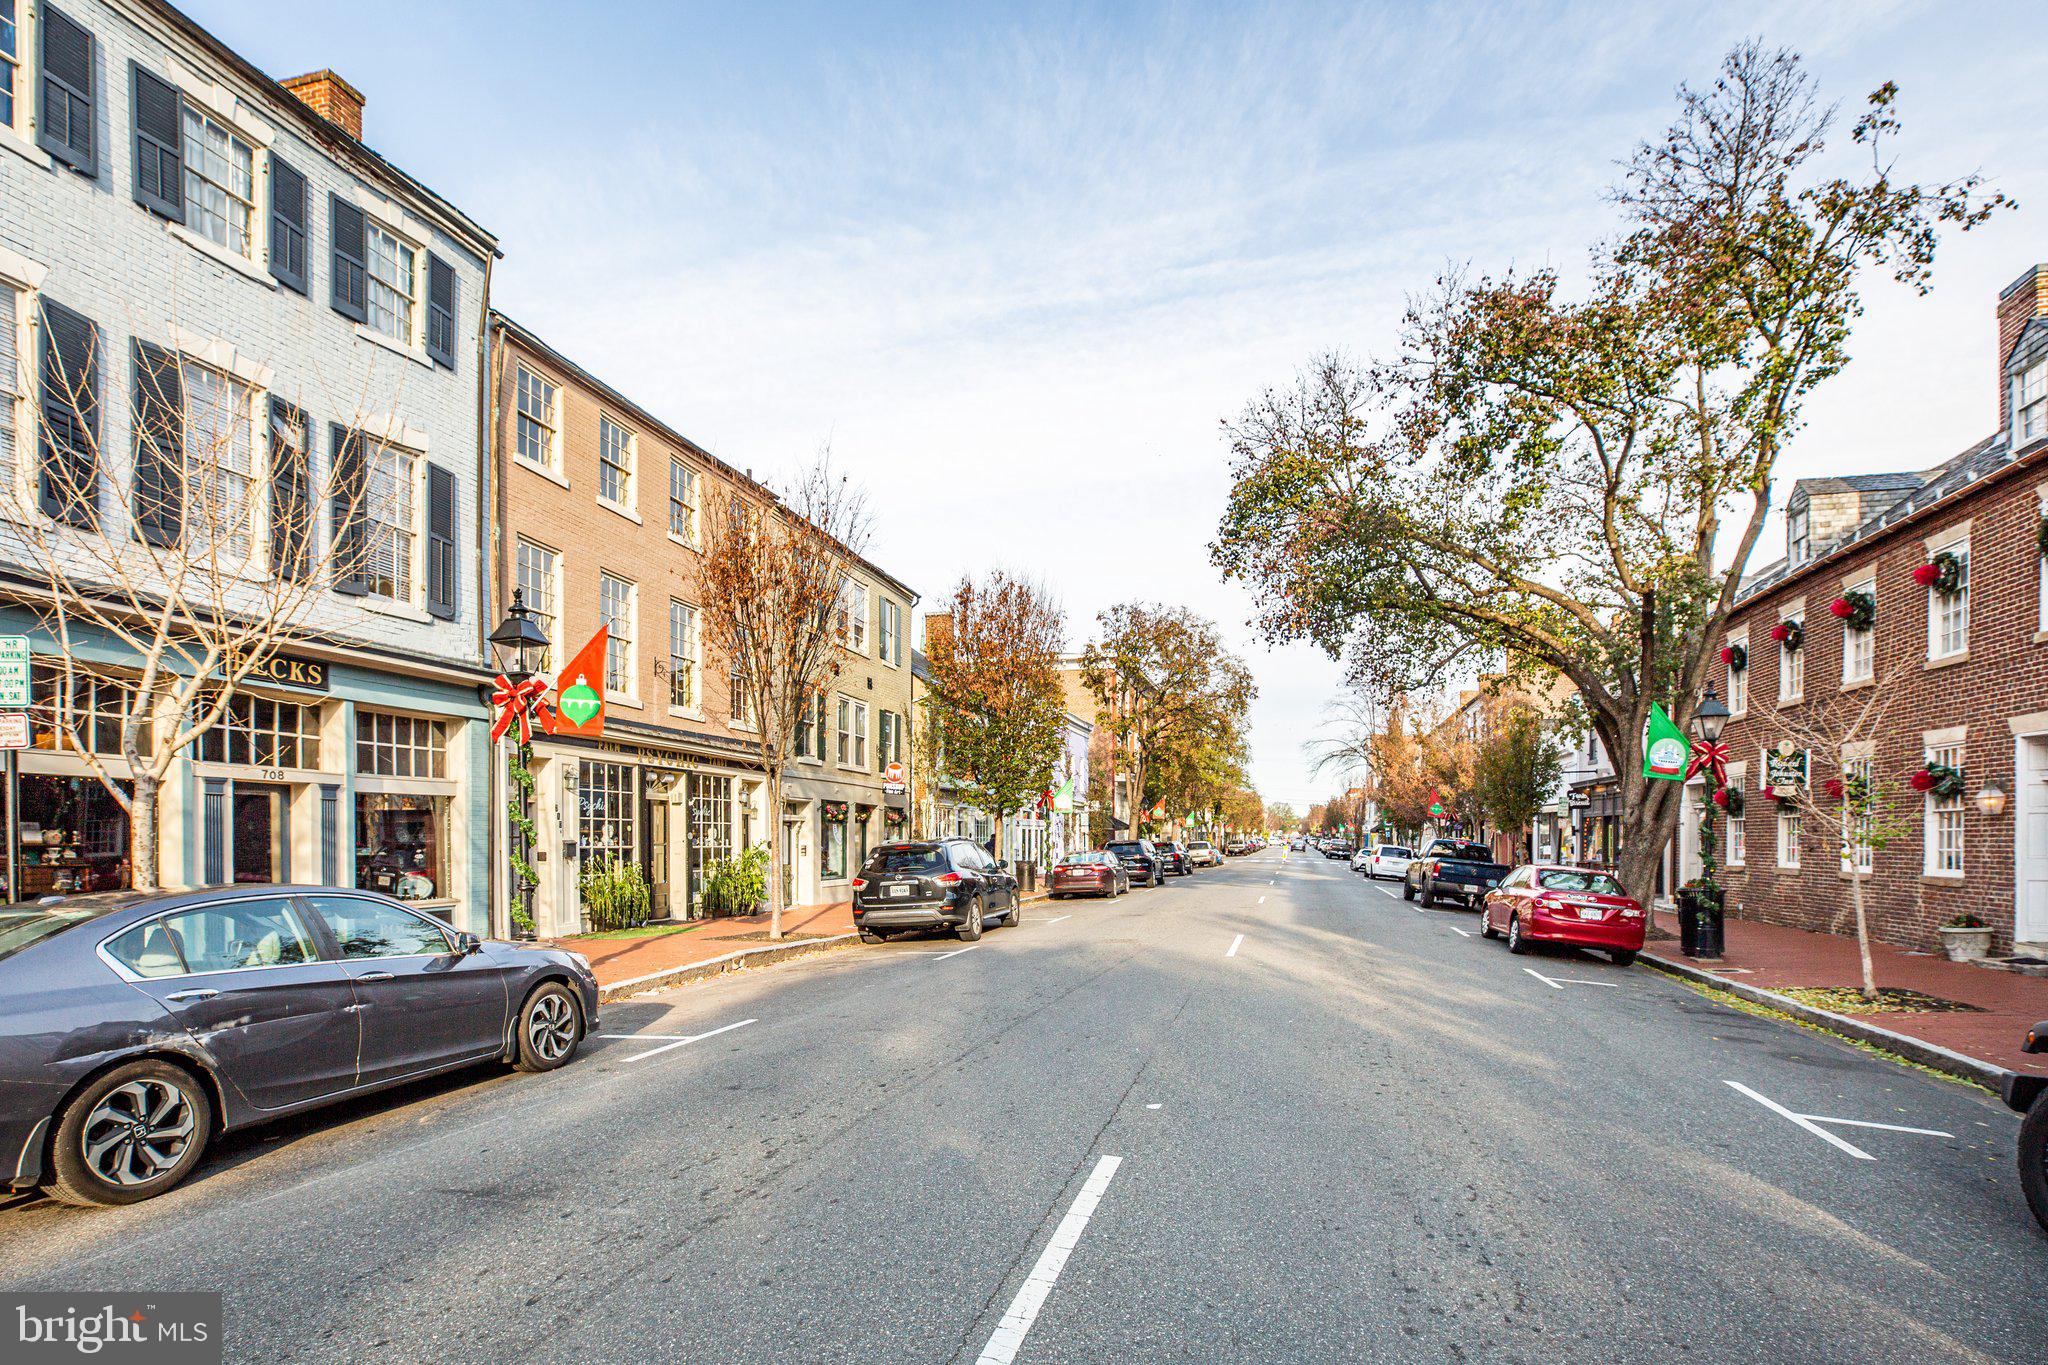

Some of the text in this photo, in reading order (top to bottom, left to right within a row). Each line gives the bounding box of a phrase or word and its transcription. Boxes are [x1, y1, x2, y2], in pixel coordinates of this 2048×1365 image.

[0, 650, 26, 660] ARKING
[636, 745, 699, 770] PSYCHIC
[261, 769, 285, 780] 708
